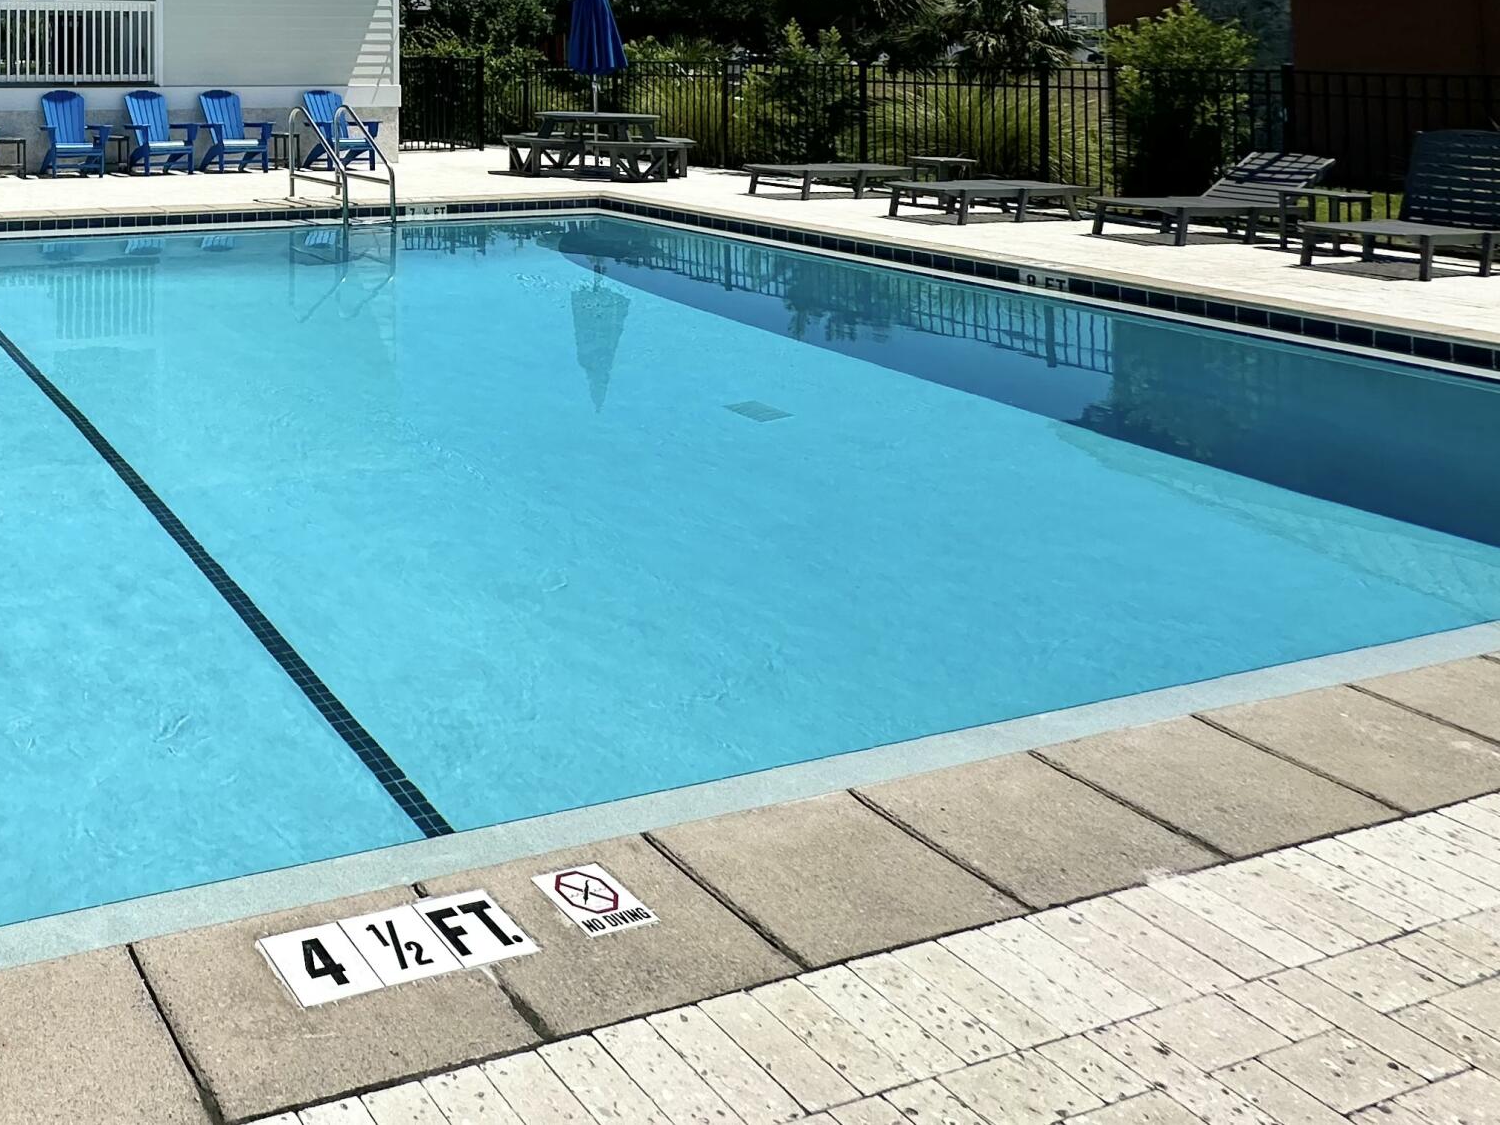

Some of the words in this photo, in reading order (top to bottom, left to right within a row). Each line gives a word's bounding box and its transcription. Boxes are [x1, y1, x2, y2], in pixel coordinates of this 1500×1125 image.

[1045, 277, 1066, 290] FT
[581, 918, 607, 933] NO
[602, 907, 652, 928] DIVING
[301, 937, 350, 986] 4
[424, 899, 525, 957] FT.
